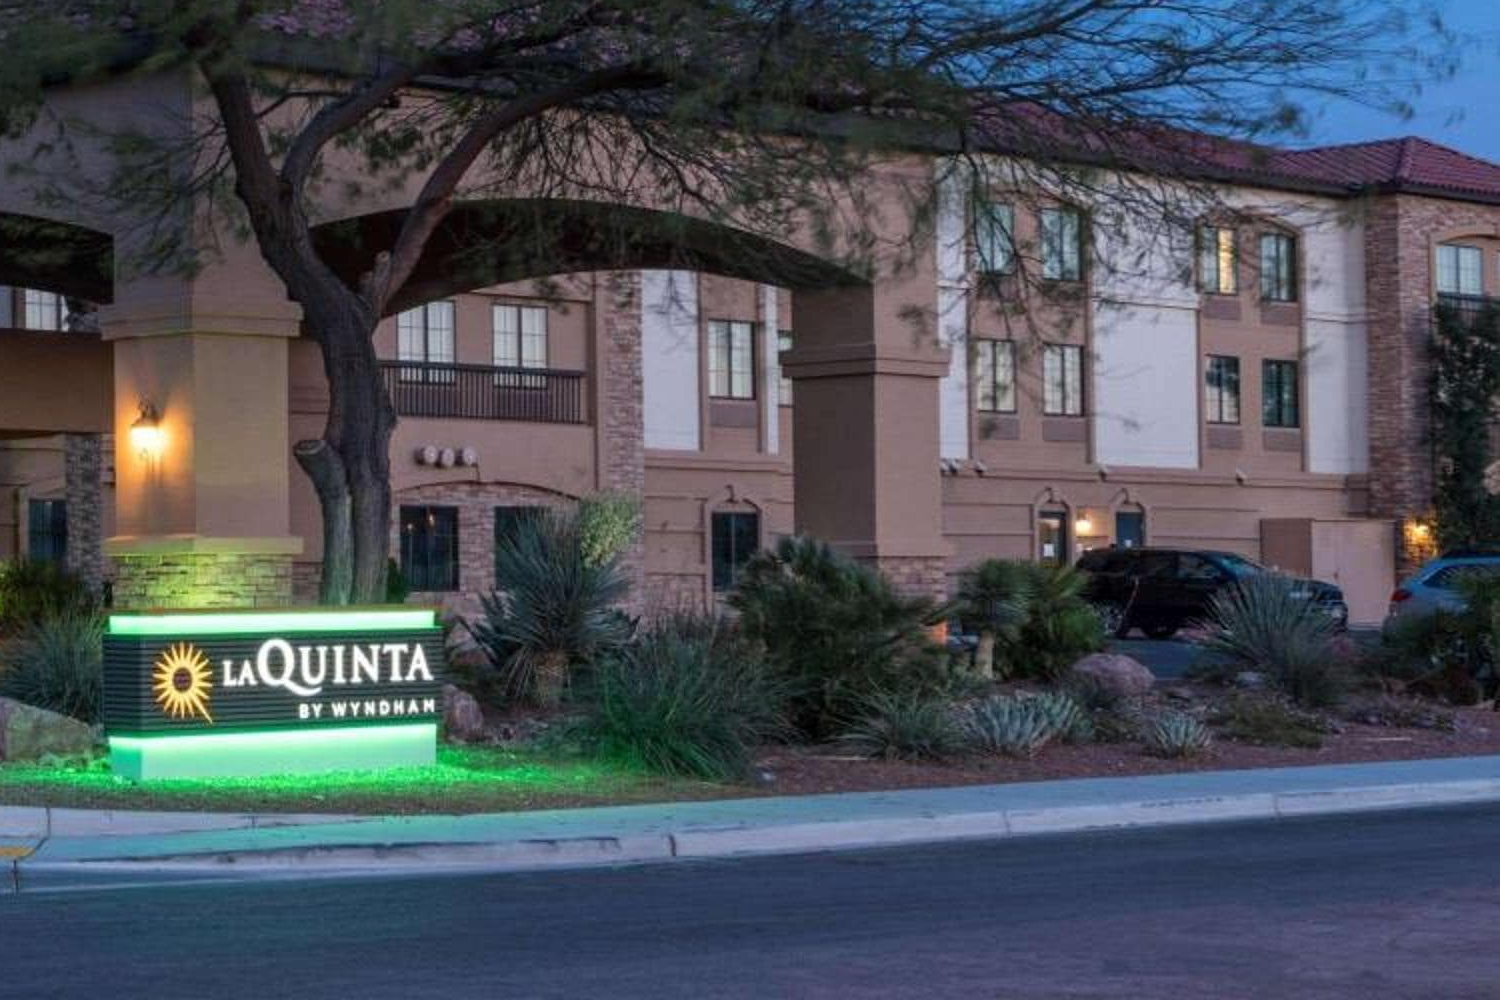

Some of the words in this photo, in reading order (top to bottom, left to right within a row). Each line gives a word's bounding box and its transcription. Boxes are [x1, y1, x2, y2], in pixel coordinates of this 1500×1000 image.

[222, 659, 257, 687] LA
[257, 638, 434, 696] QUINTA
[299, 703, 322, 718] BY
[332, 699, 436, 717] WYNDHAM
